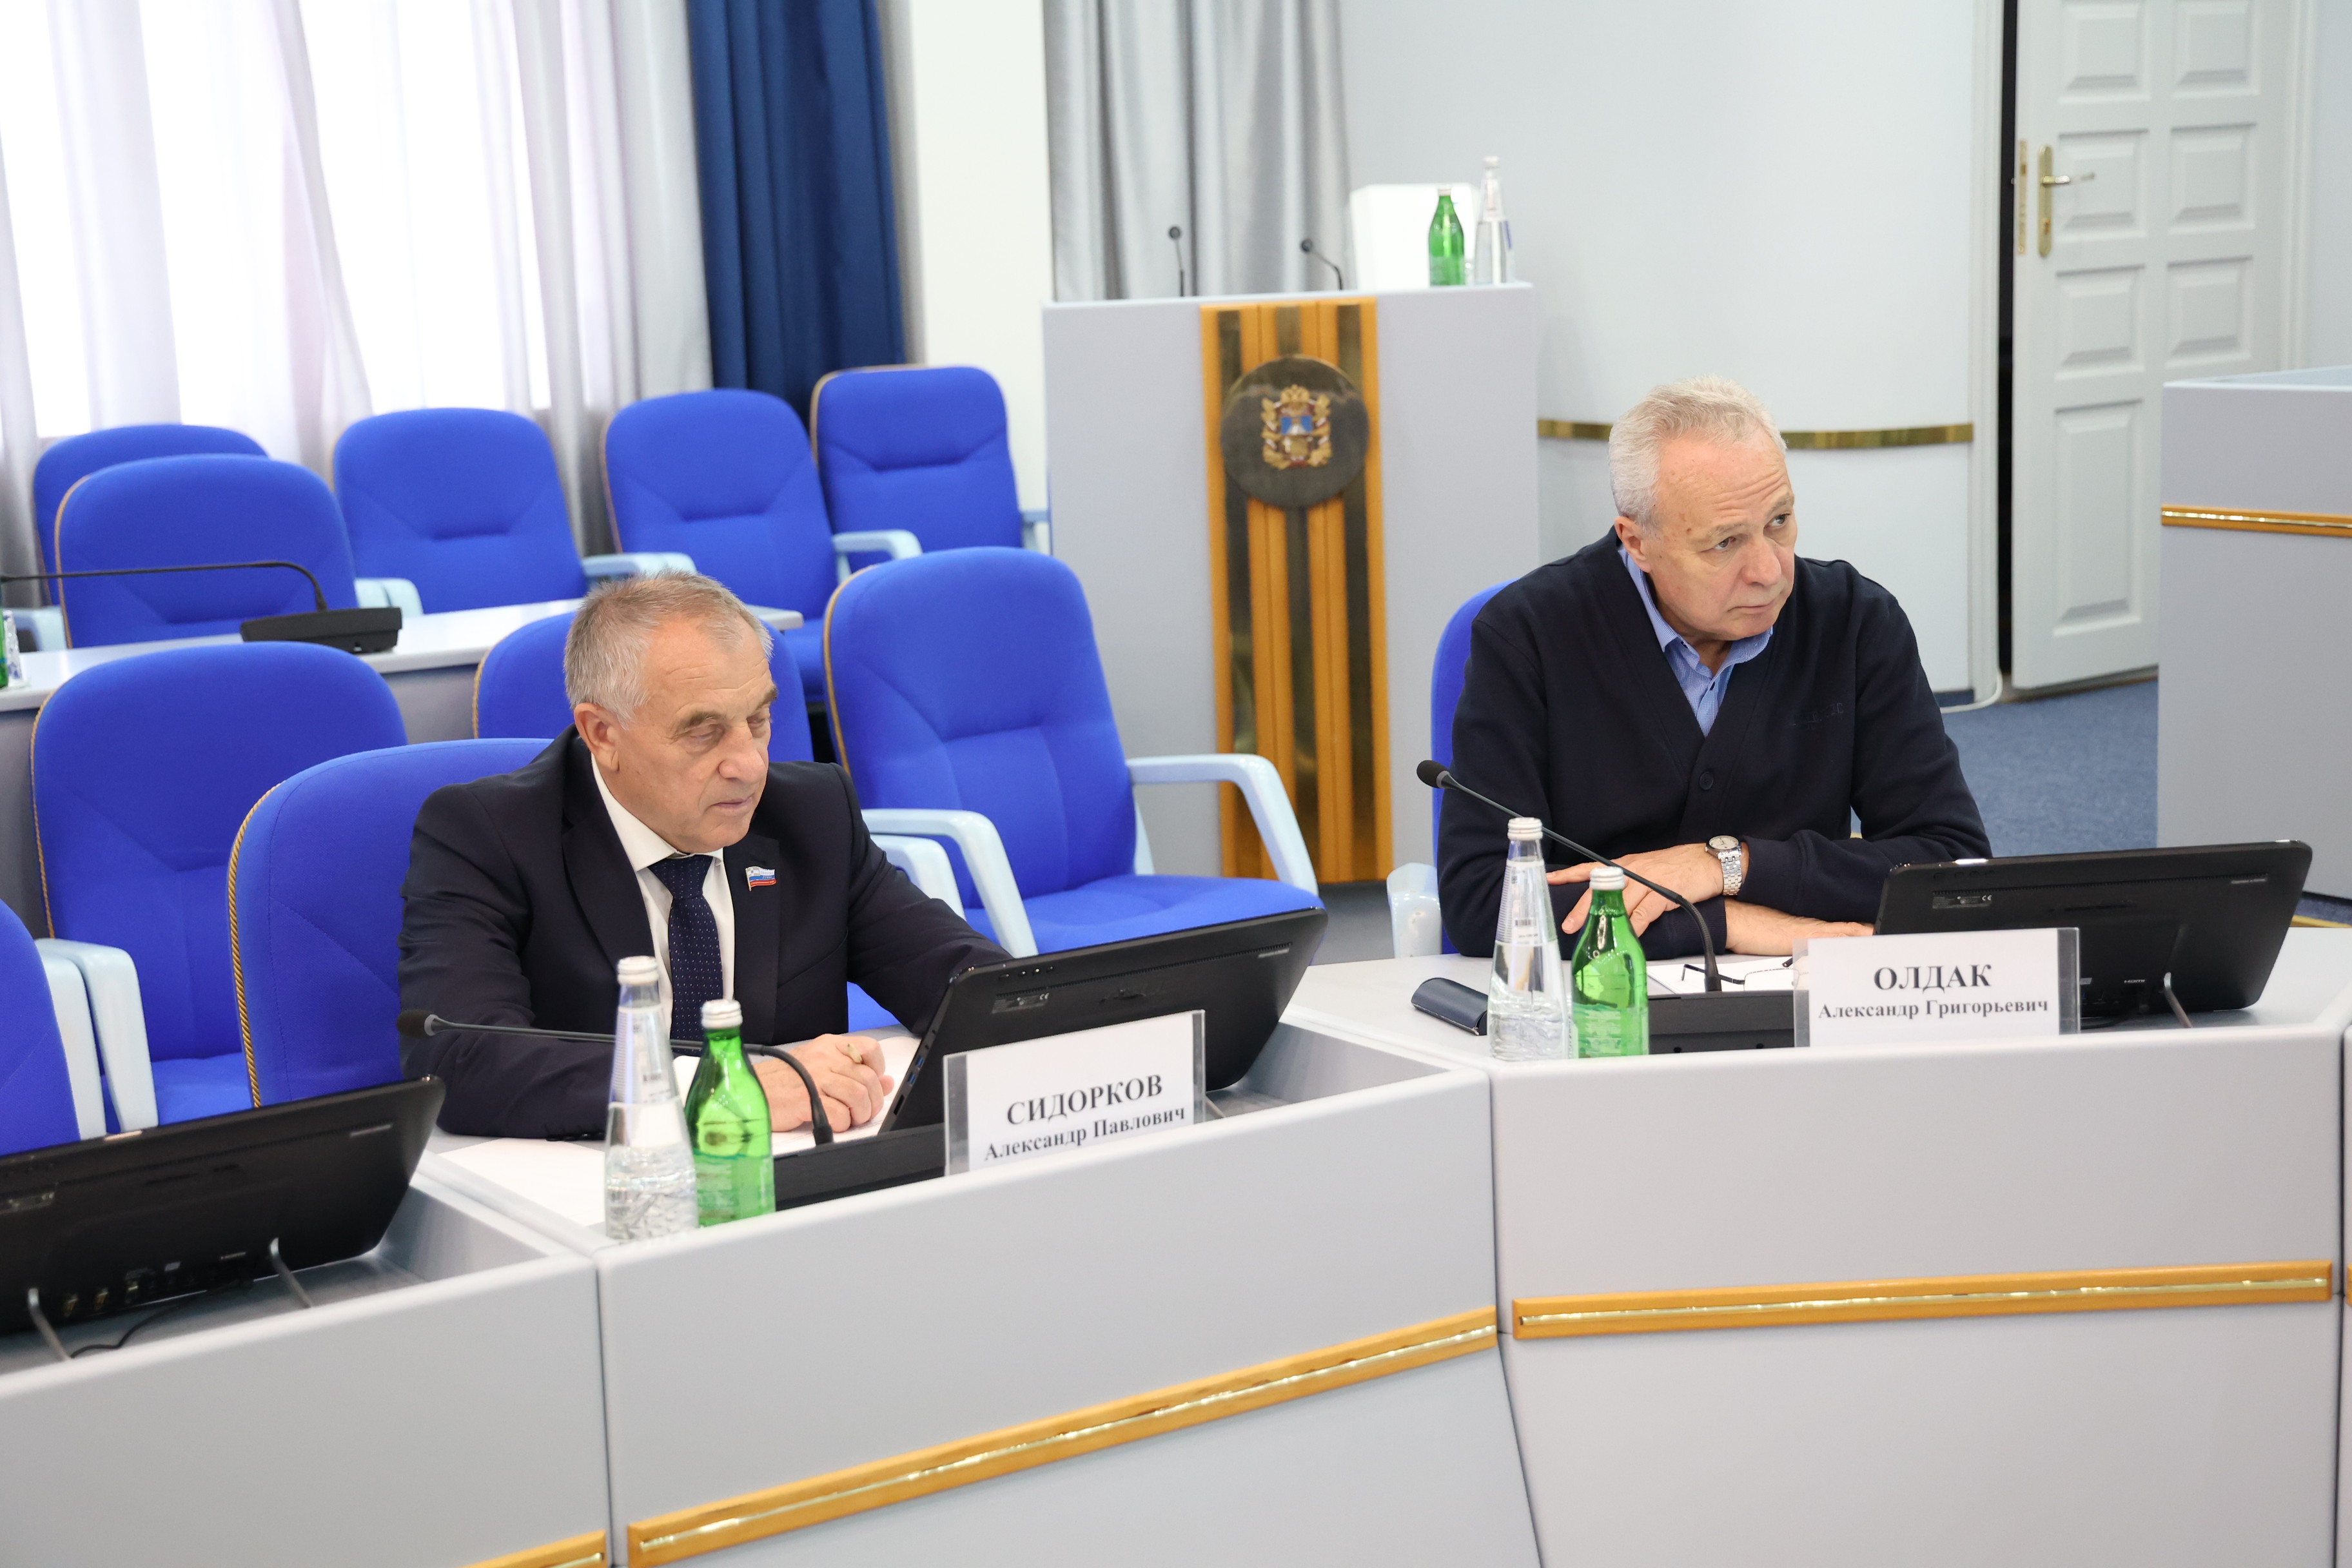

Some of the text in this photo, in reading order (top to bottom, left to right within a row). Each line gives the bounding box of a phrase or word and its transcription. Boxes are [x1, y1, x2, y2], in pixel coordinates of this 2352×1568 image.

[1874, 964, 1992, 993] ОЛДАК
[1818, 999, 2049, 1019] Александр Григорьевич
[1007, 1074, 1163, 1126] СИДОРКОВ
[985, 1107, 1186, 1161] Александр Павлович
